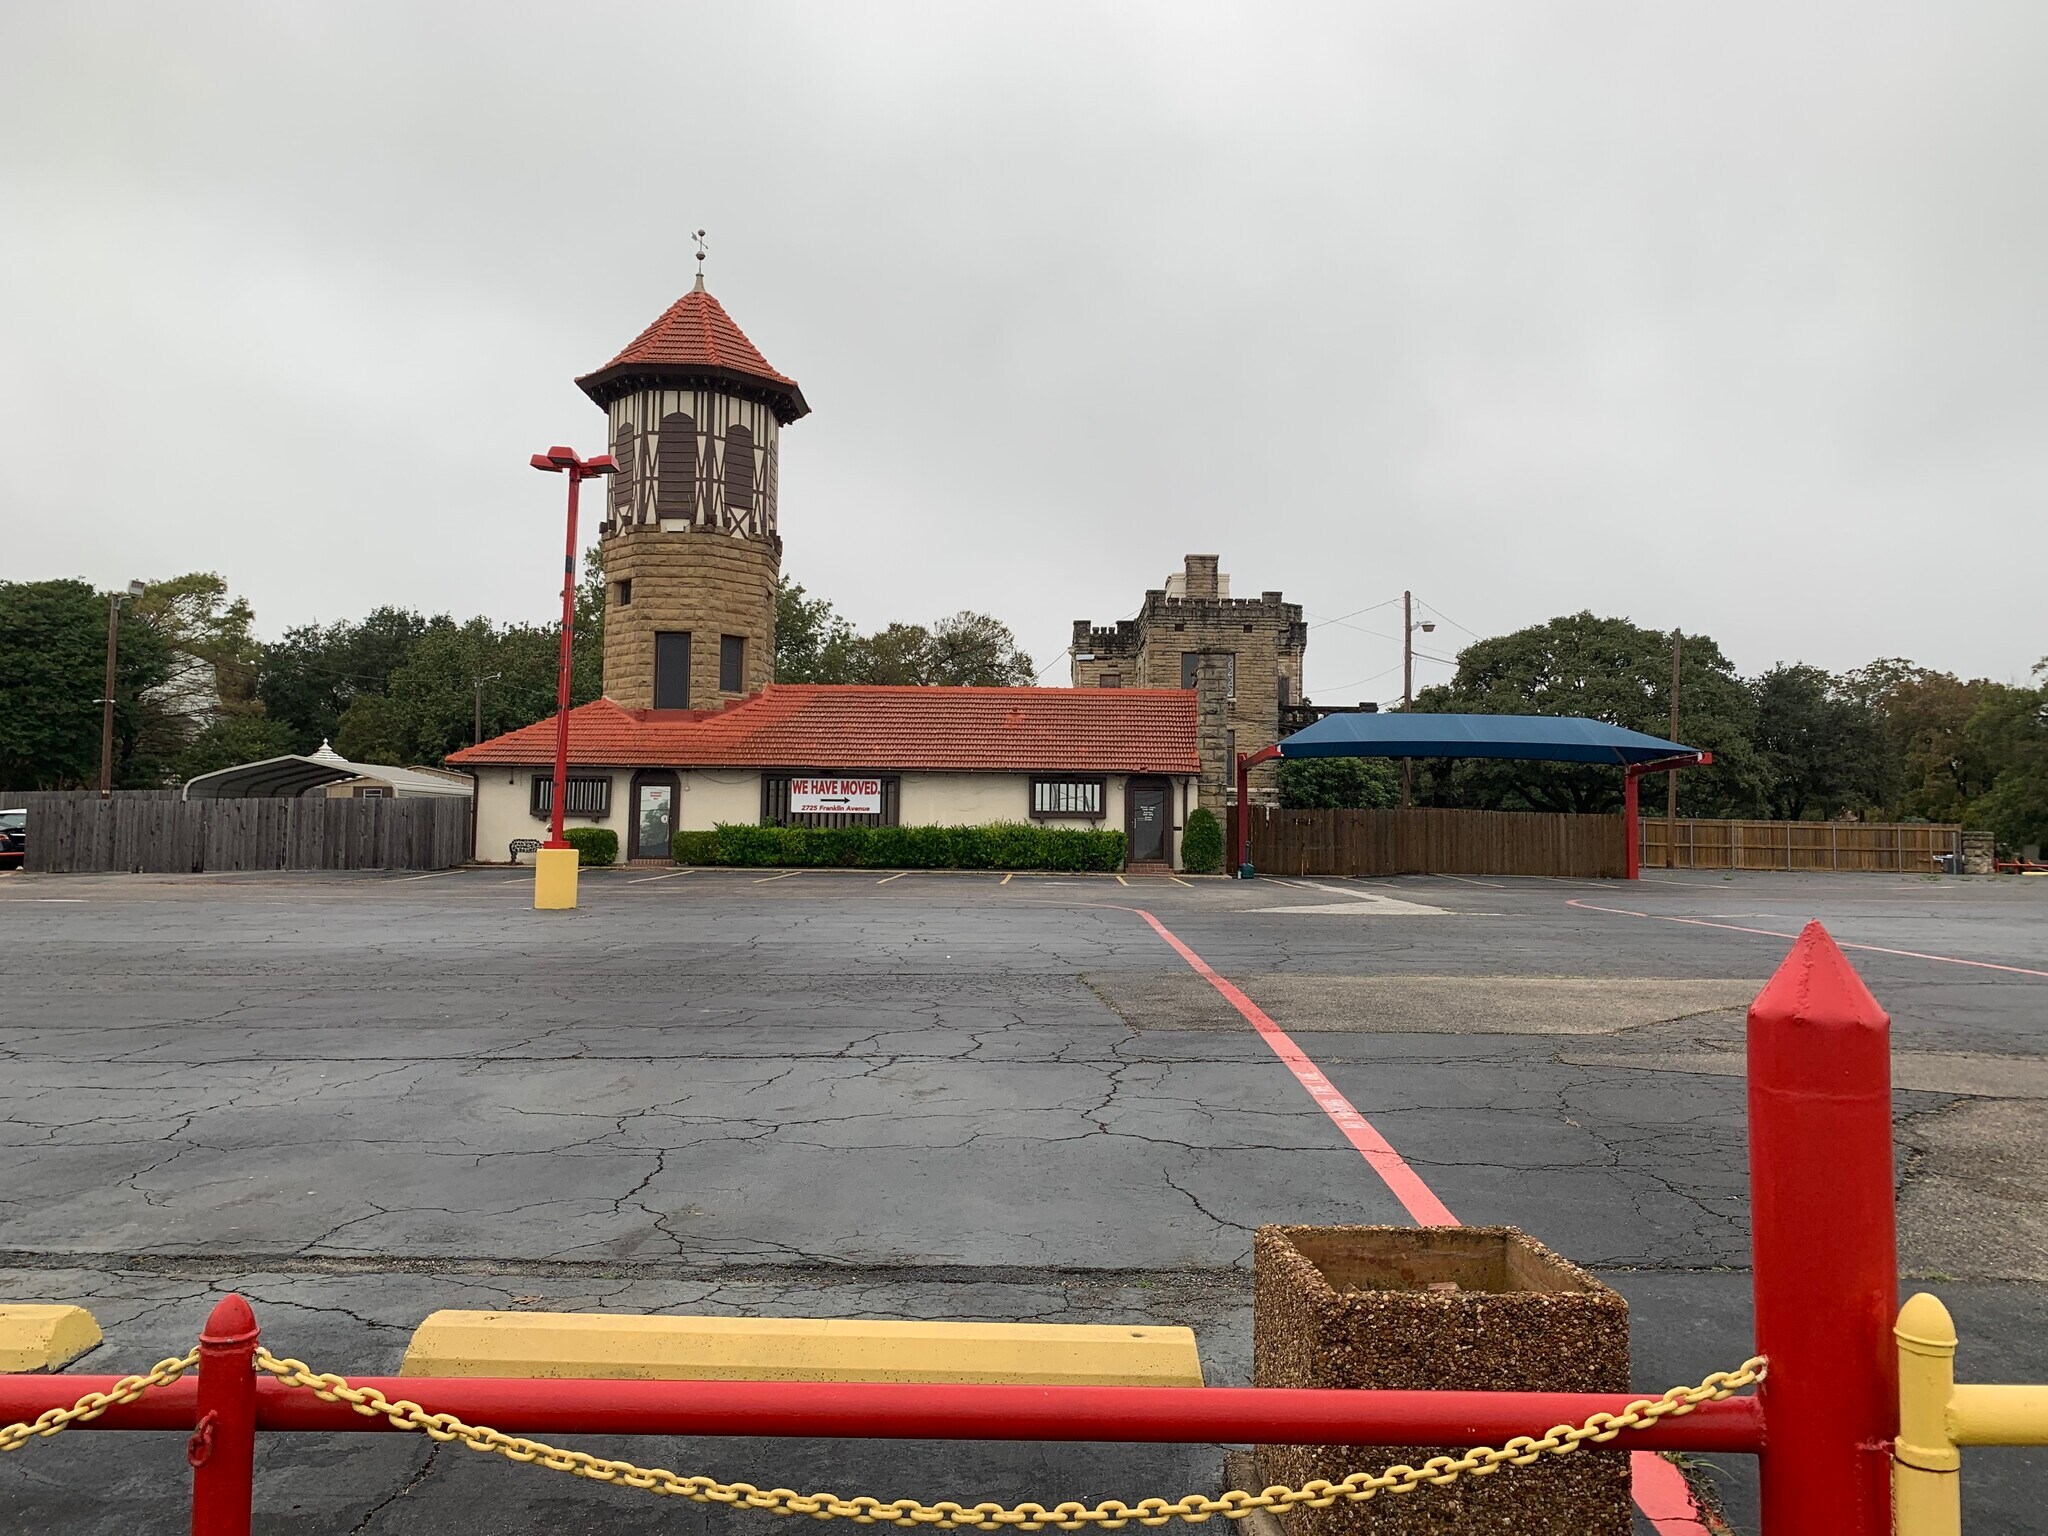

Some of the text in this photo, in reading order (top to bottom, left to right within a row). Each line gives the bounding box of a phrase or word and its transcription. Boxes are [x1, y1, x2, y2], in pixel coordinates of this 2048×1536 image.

[792, 780, 880, 795] WE HAVE MOVED.
